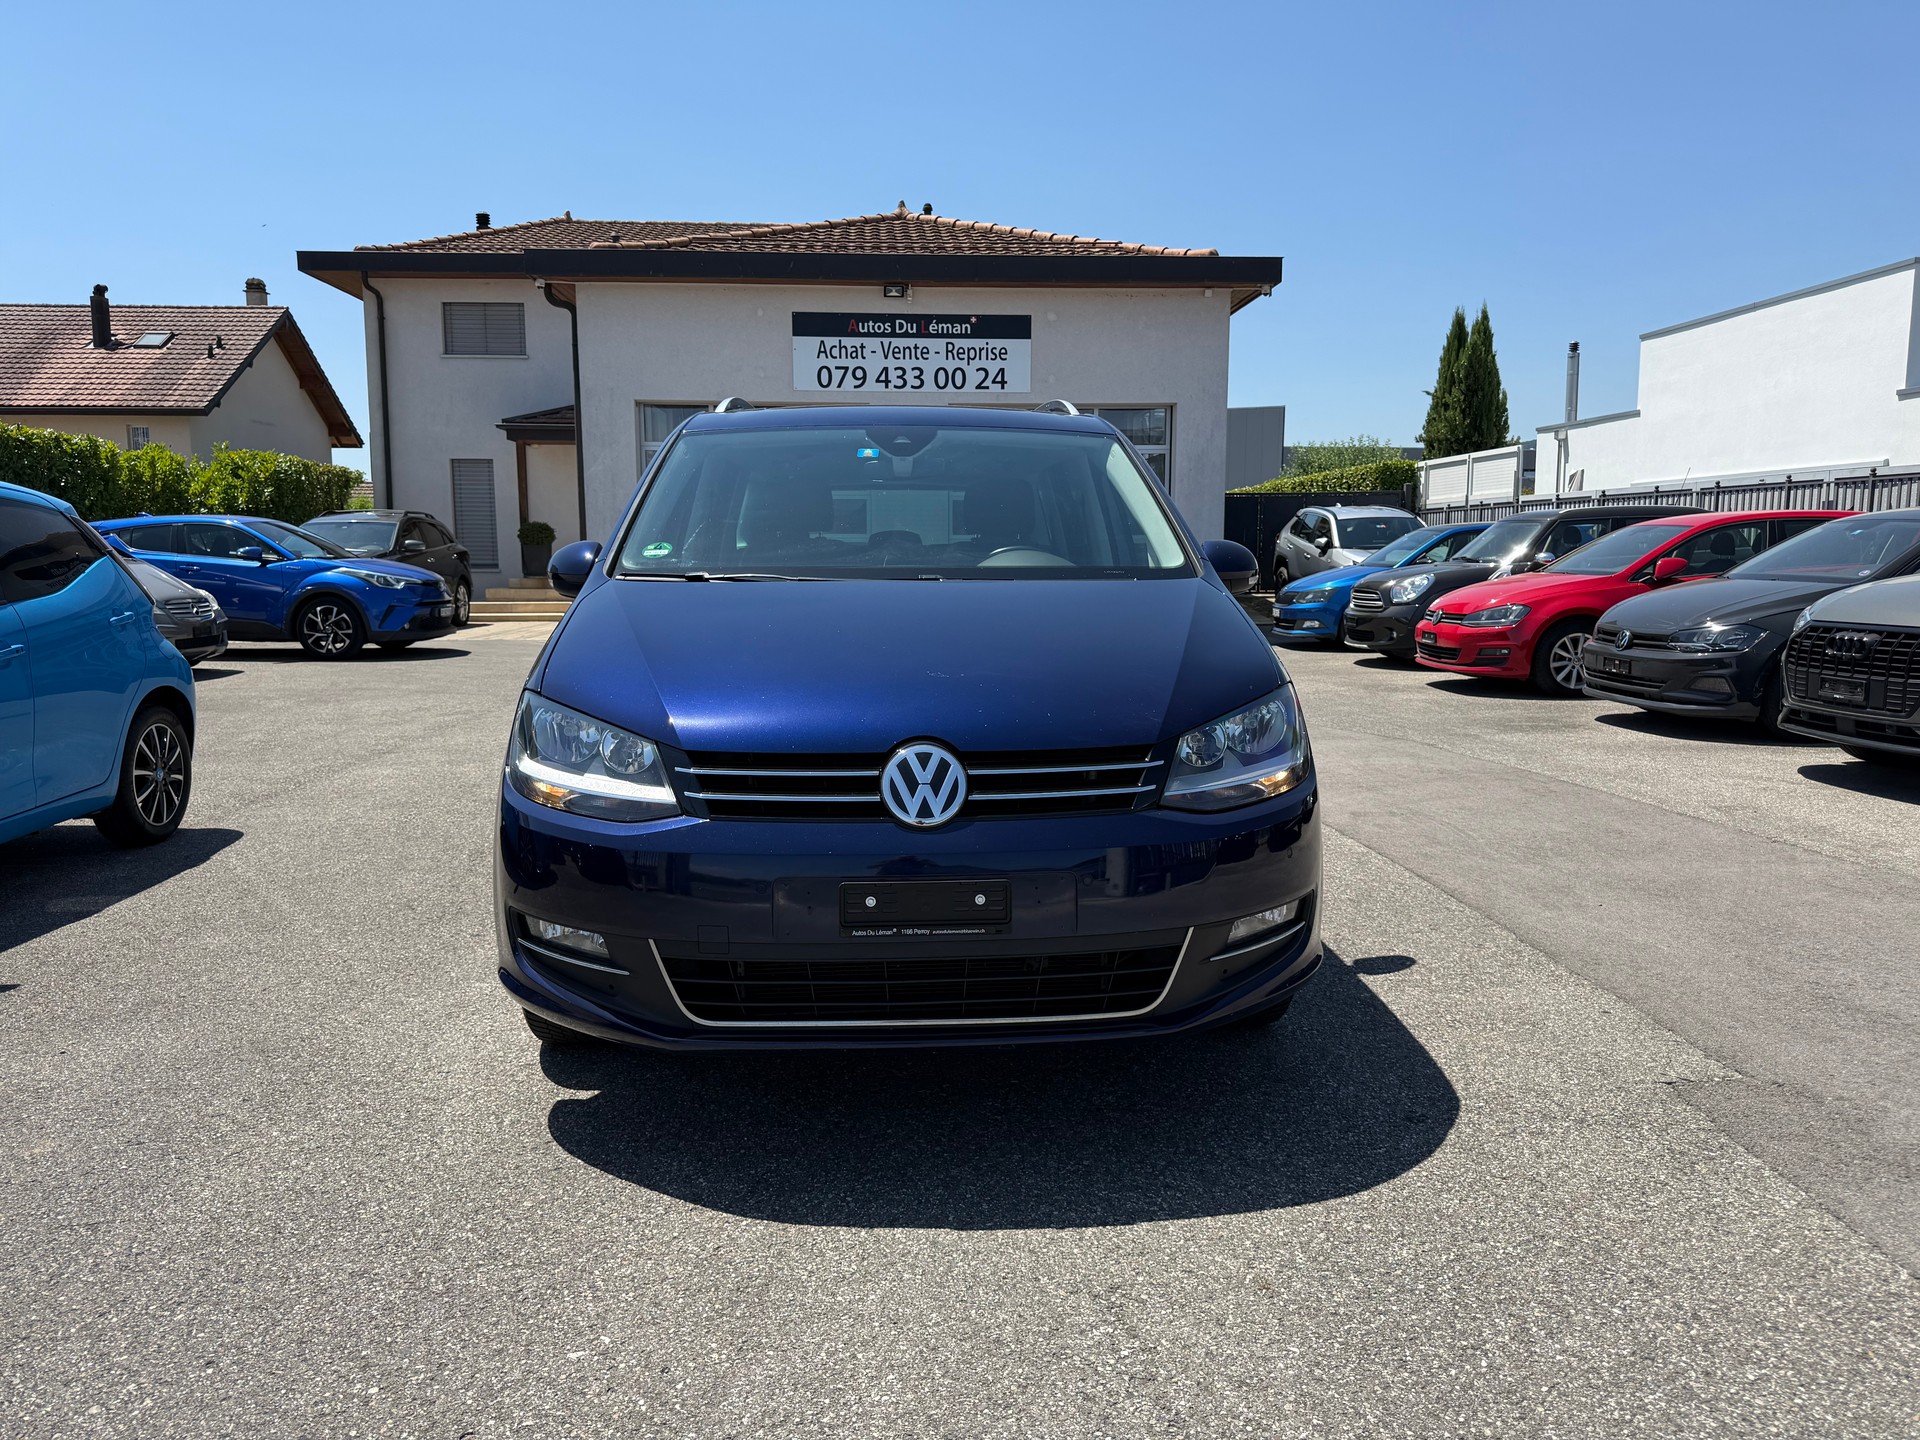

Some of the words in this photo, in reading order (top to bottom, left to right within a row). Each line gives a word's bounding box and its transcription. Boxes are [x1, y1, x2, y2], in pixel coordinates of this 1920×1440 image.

[848, 319, 891, 333] Autos
[895, 320, 917, 334] Du
[921, 320, 971, 335] Léman
[816, 339, 866, 359] Achat
[880, 341, 930, 361] Vente
[945, 342, 1008, 366] Reprise
[816, 366, 867, 389] 079
[875, 366, 925, 390] 433
[933, 367, 967, 390] 00
[974, 368, 1008, 390] 24
[885, 747, 963, 823] VW
[875, 928, 892, 936] Léman
